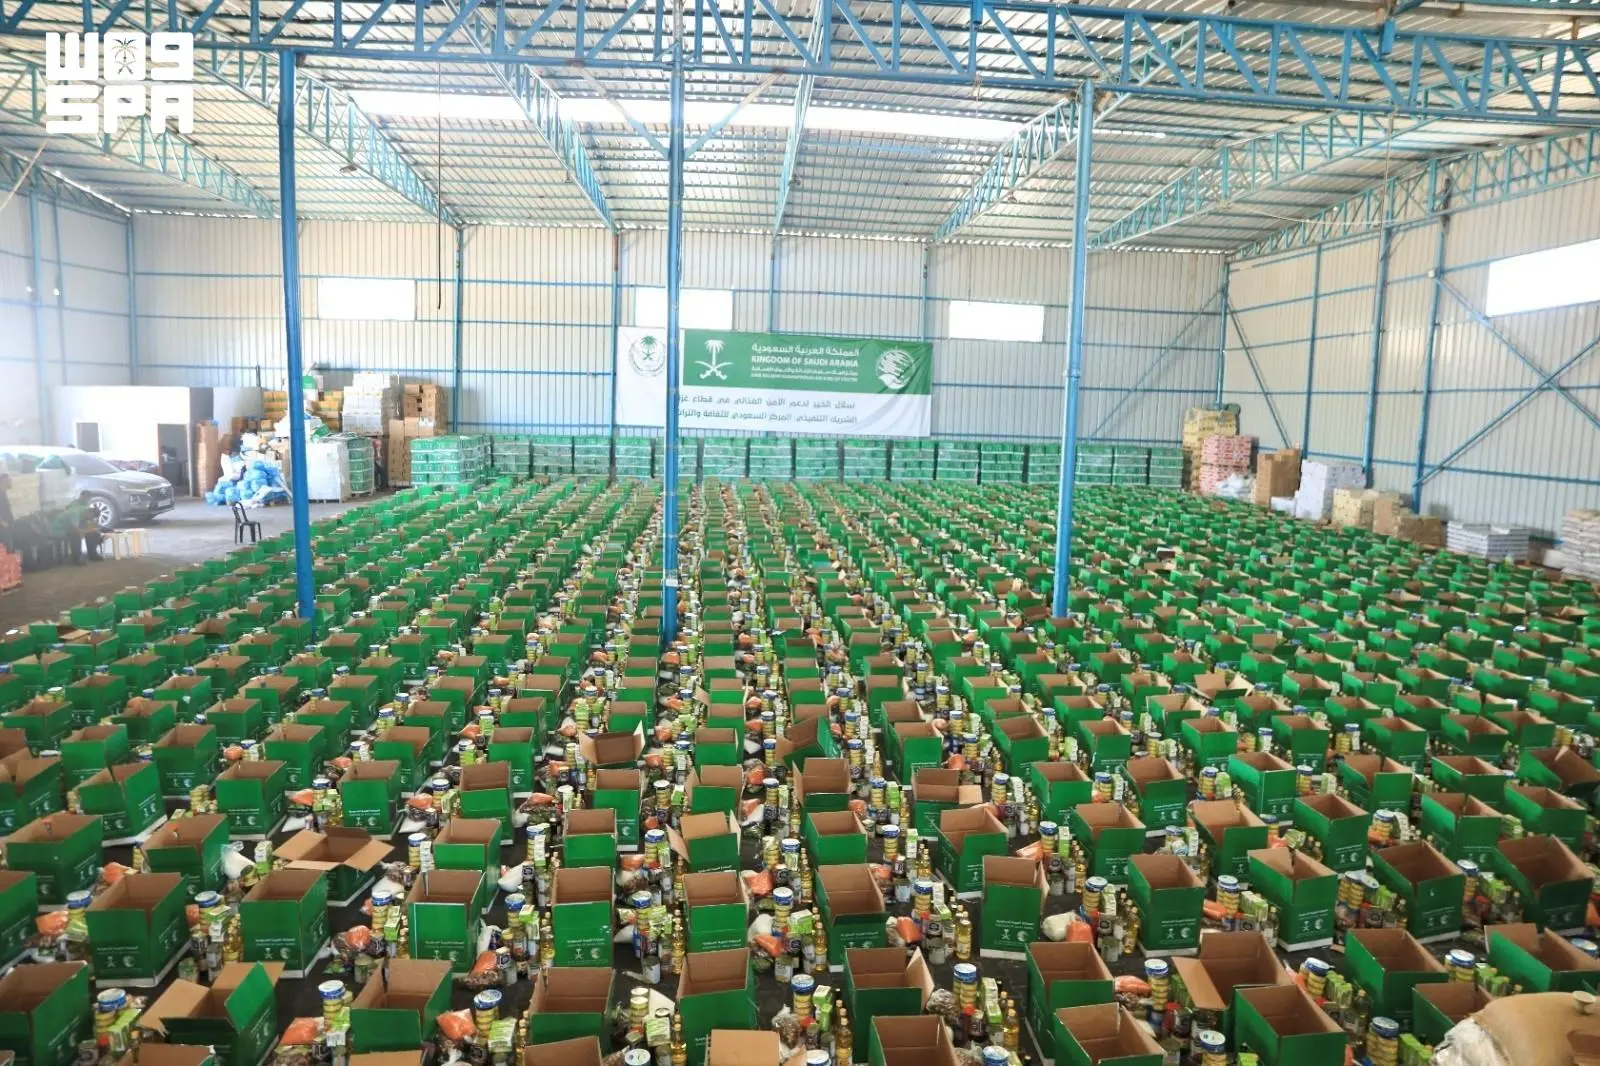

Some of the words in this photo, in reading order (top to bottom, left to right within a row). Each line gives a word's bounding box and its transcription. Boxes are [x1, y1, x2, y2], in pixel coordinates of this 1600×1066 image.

[751, 343, 793, 354] السعودية
[794, 345, 824, 355] العربية
[825, 347, 859, 357] المملكة
[751, 355, 790, 365] KINGDOM
[791, 357, 802, 365] OF
[803, 357, 828, 366] SAUDI
[828, 359, 859, 368] ARABIA
[680, 394, 689, 403] غز
